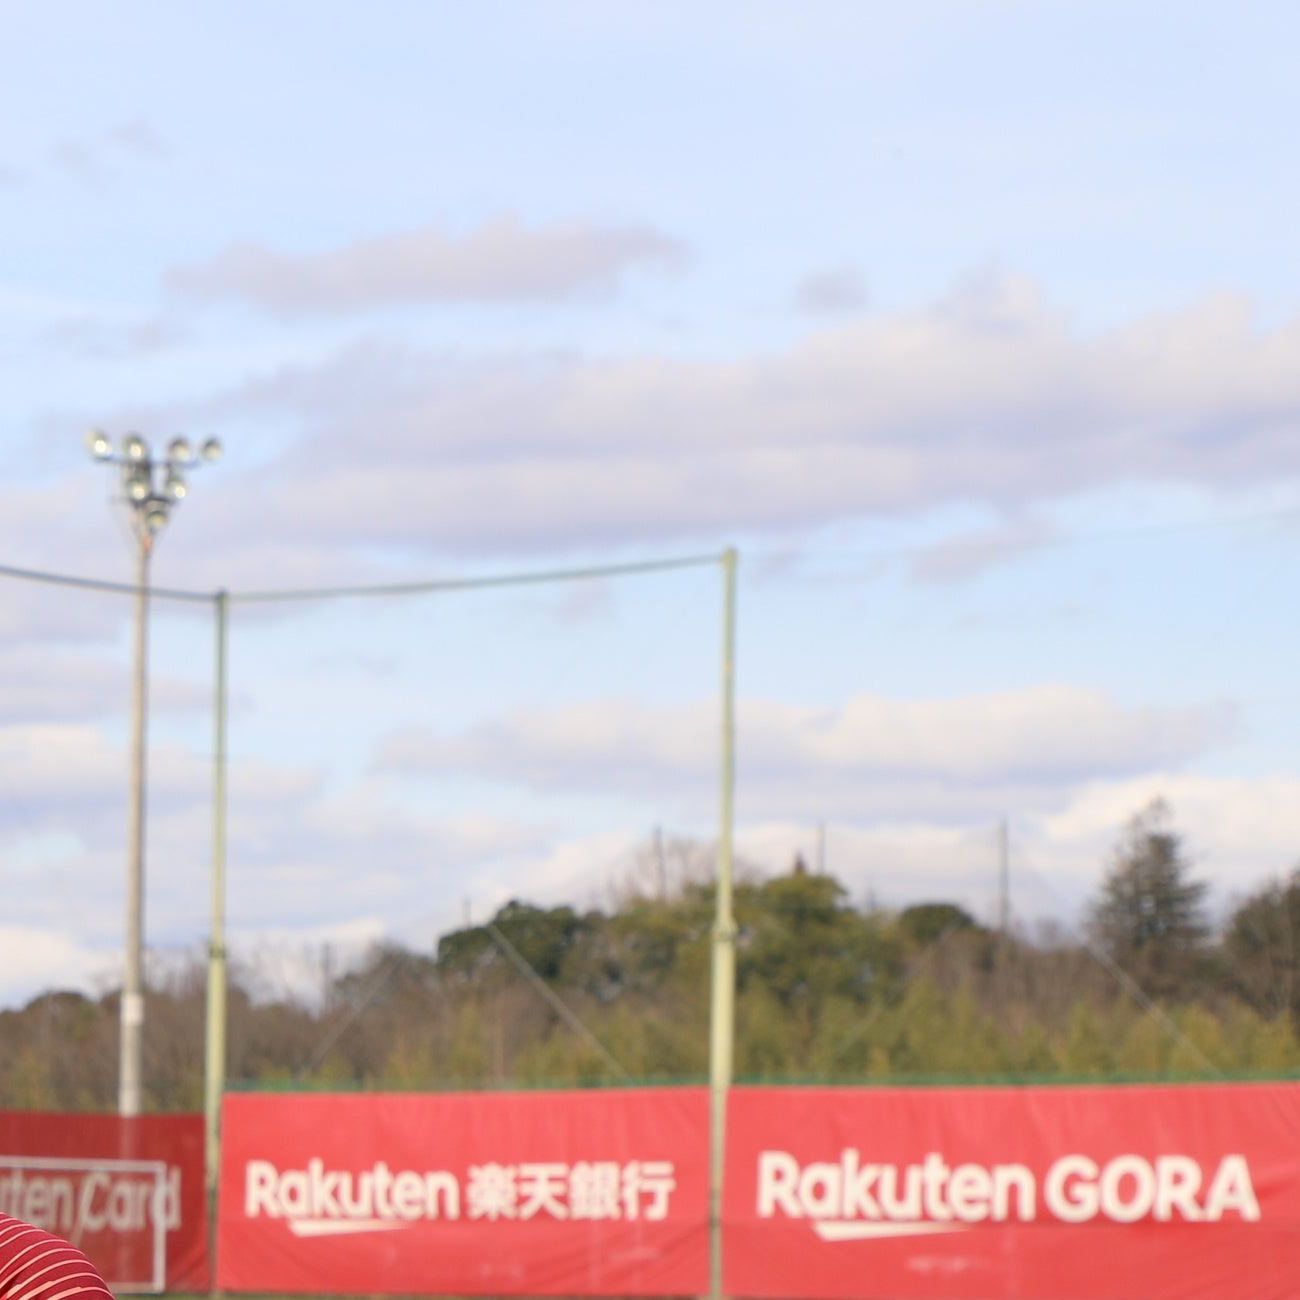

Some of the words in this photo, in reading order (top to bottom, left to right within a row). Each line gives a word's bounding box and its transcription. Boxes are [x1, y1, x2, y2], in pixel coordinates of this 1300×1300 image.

[244, 1157, 460, 1220] Rakuten
[466, 1160, 676, 1221] 楽天銀行
[757, 1148, 1037, 1221] Rakuten
[1044, 1153, 1261, 1223] GORA
